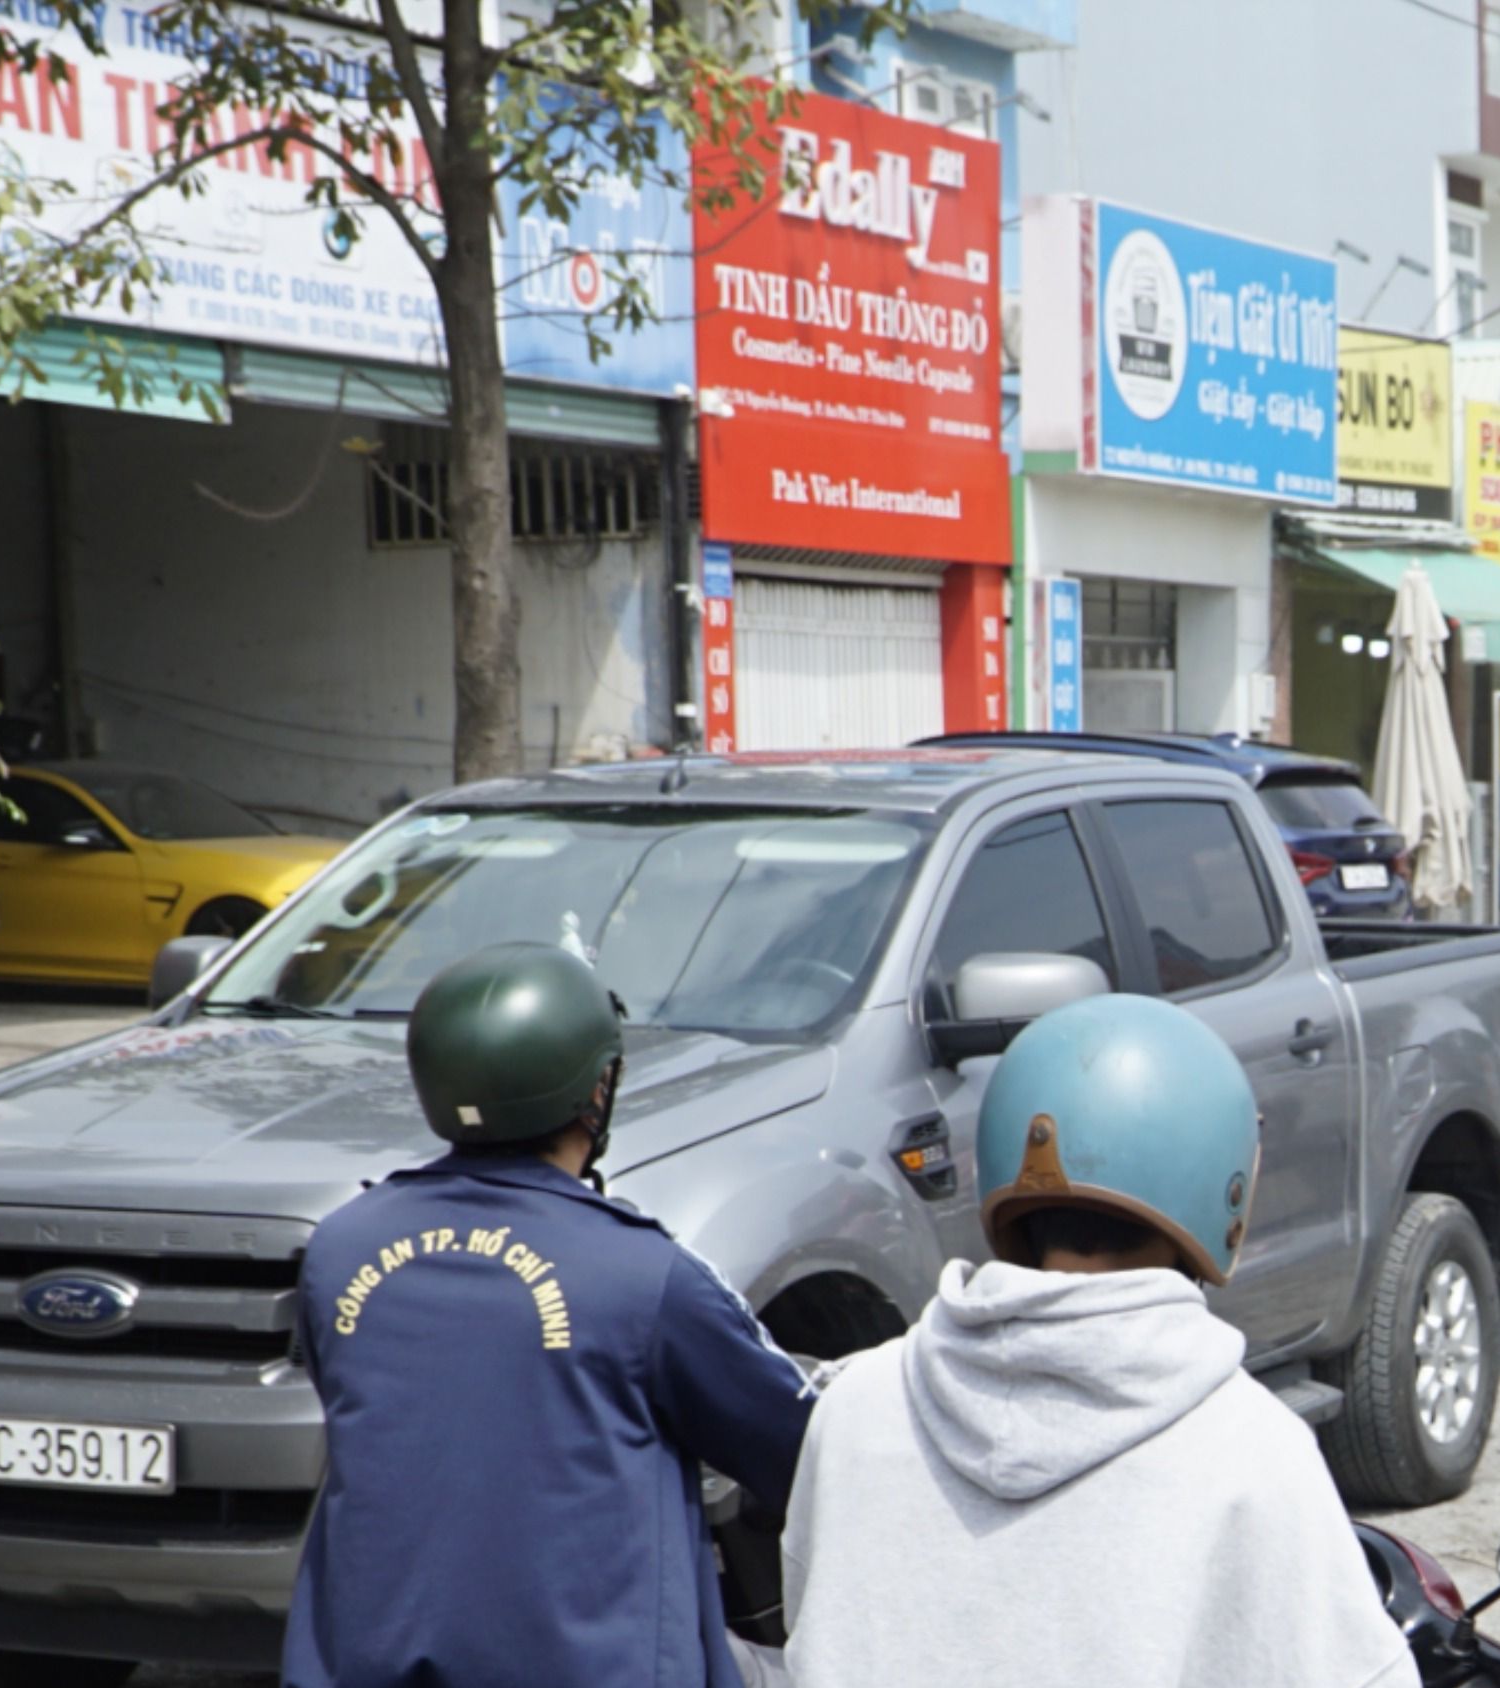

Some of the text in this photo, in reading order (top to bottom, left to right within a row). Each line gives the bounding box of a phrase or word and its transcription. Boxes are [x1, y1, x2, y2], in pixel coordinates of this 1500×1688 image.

[777, 126, 938, 268] Edally
[714, 263, 788, 320] TINH
[857, 286, 948, 350] THÔNG
[1188, 268, 1236, 366] Tiệm
[1237, 282, 1275, 376] Giặt
[732, 327, 815, 368] Cosmetics
[826, 342, 863, 376] Pine
[863, 348, 915, 384] Needle
[916, 358, 975, 394] Capsule
[772, 468, 961, 520] Pak Viet International
[37, 1286, 102, 1319] Ford
[335, 1263, 383, 1336] CÔNG
[379, 1238, 415, 1273] AN
[420, 1228, 462, 1254] TP.
[503, 1243, 556, 1285] CHÍ
[531, 1278, 572, 1350] MINH
